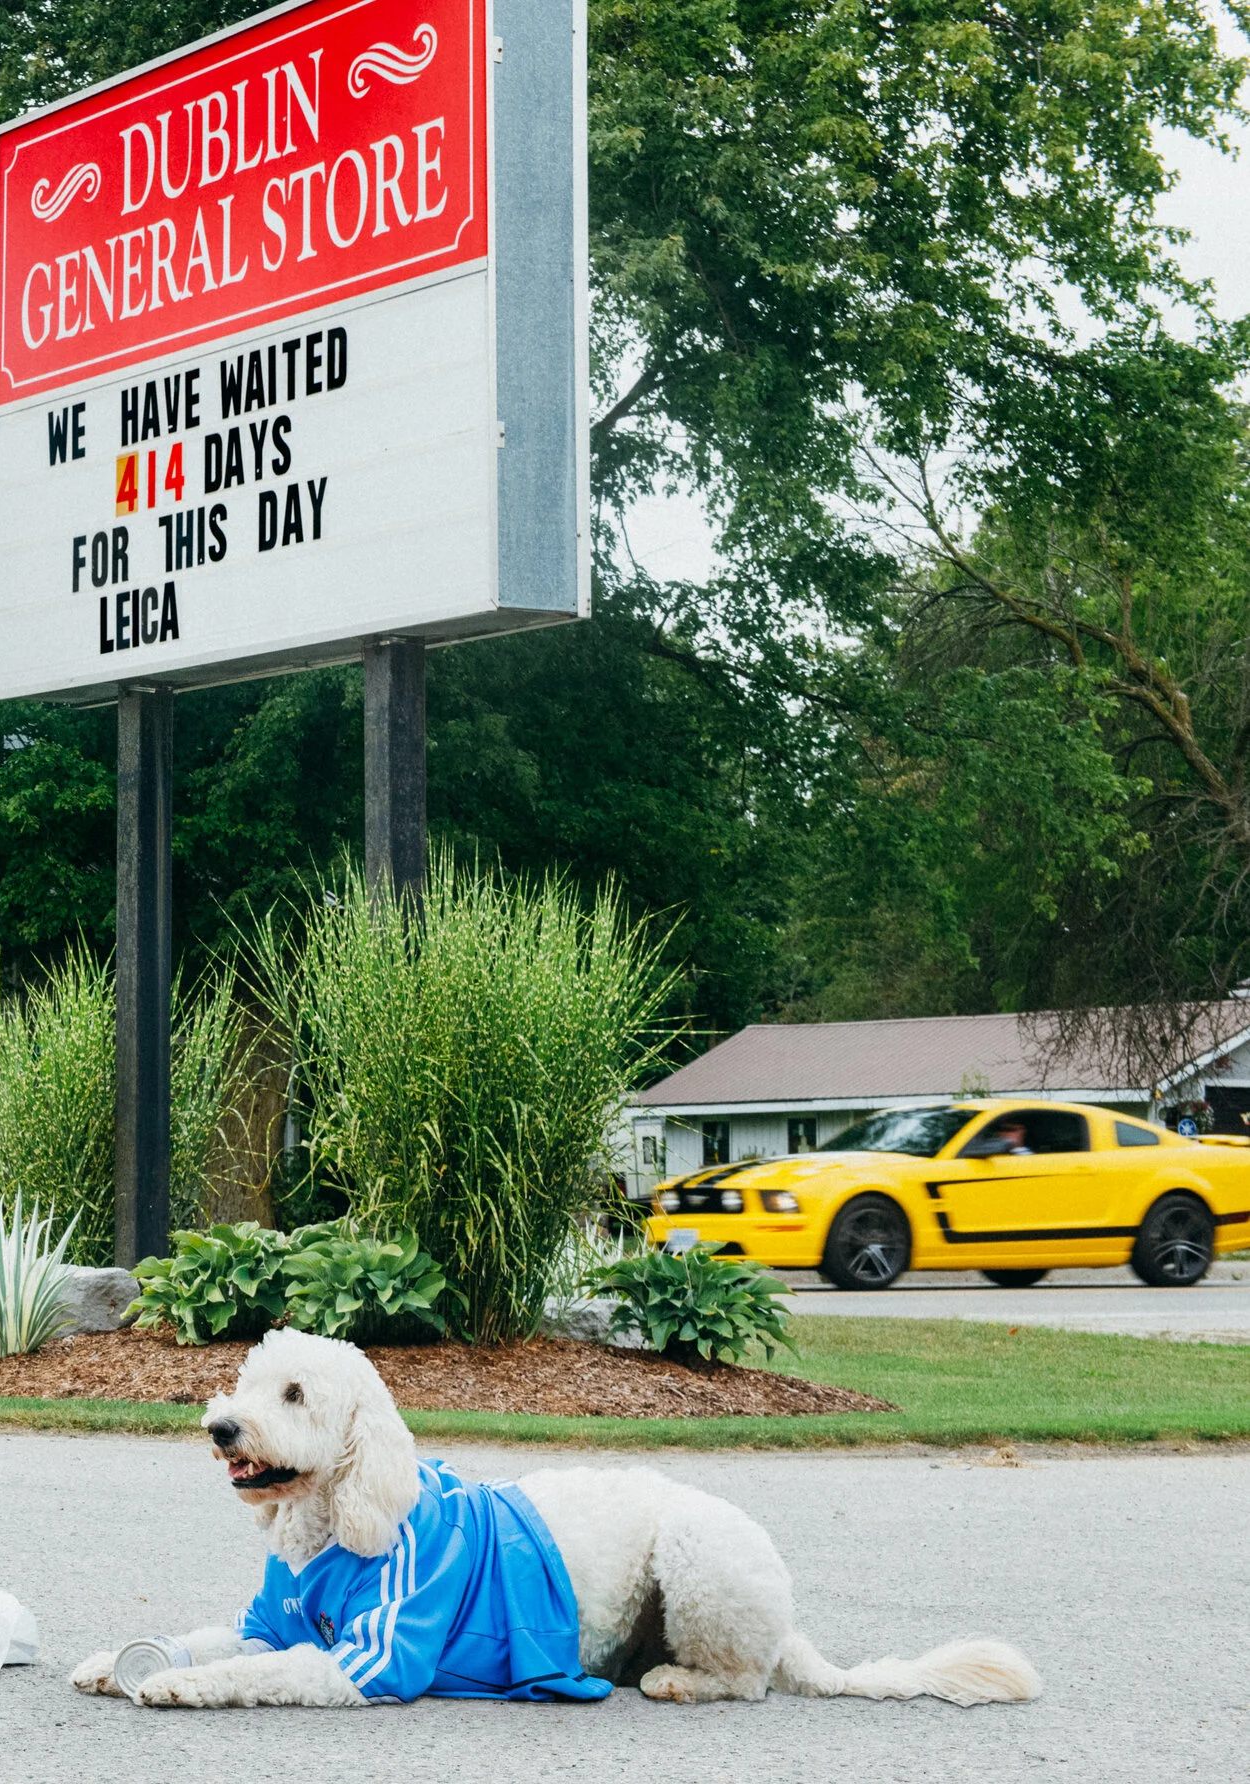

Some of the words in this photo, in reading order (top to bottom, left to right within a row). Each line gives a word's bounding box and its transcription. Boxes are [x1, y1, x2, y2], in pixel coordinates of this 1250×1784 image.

[119, 48, 324, 217] DUBLIN
[21, 194, 249, 350] GENERAL
[261, 115, 448, 272] STORE
[47, 401, 86, 467] WE
[121, 367, 201, 448] HAVE
[219, 326, 348, 420] WAITED
[115, 441, 185, 513] 414
[204, 414, 292, 495] DAYS
[72, 525, 129, 593] FOR
[158, 503, 228, 573] THIS
[258, 476, 328, 553] DAY
[99, 580, 180, 655] LEICA
